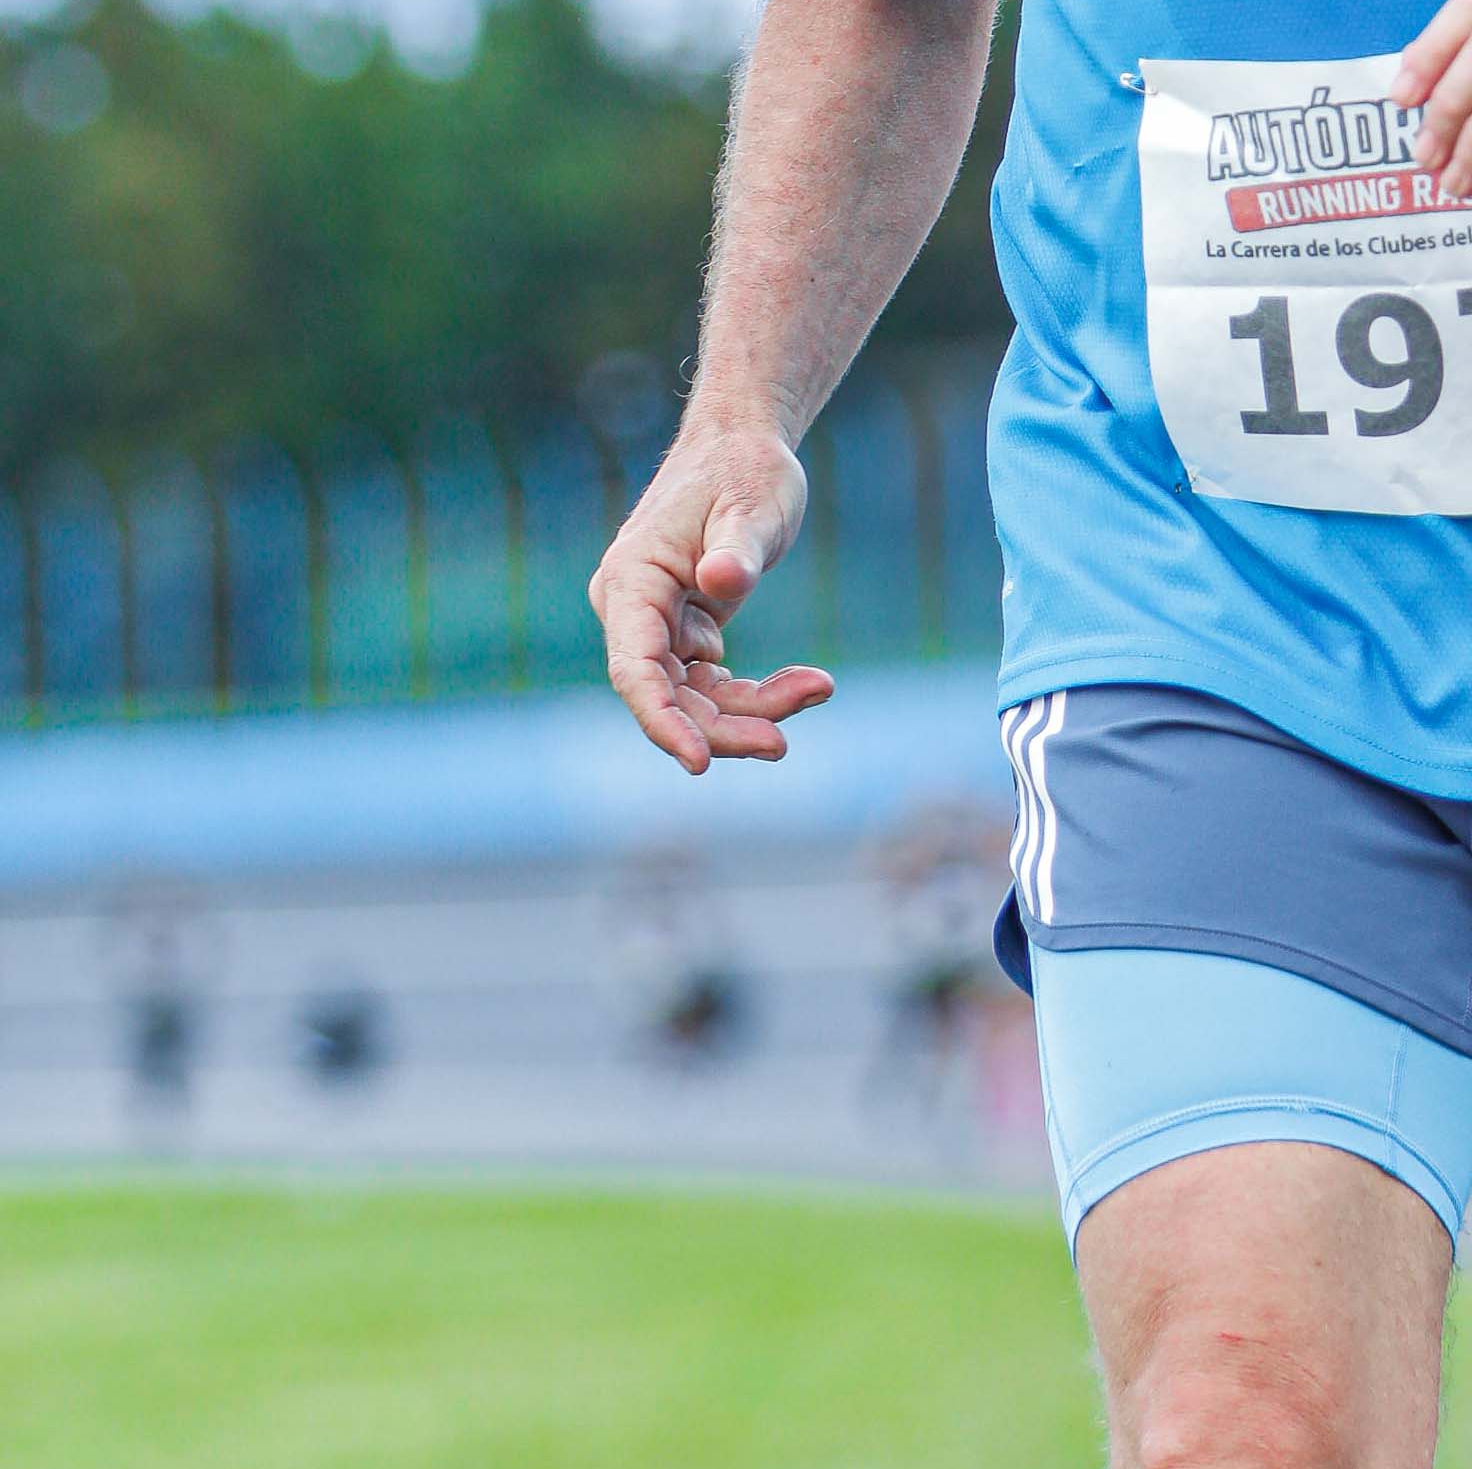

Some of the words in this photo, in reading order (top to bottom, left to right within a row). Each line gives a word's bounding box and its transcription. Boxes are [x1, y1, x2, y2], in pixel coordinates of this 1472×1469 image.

[1257, 176, 1400, 225] RUNNING
[1206, 239, 1227, 258] La
[1231, 239, 1301, 258] Carrera
[1305, 238, 1330, 257] de
[1335, 237, 1364, 256] los
[1368, 234, 1437, 255] Clubes
